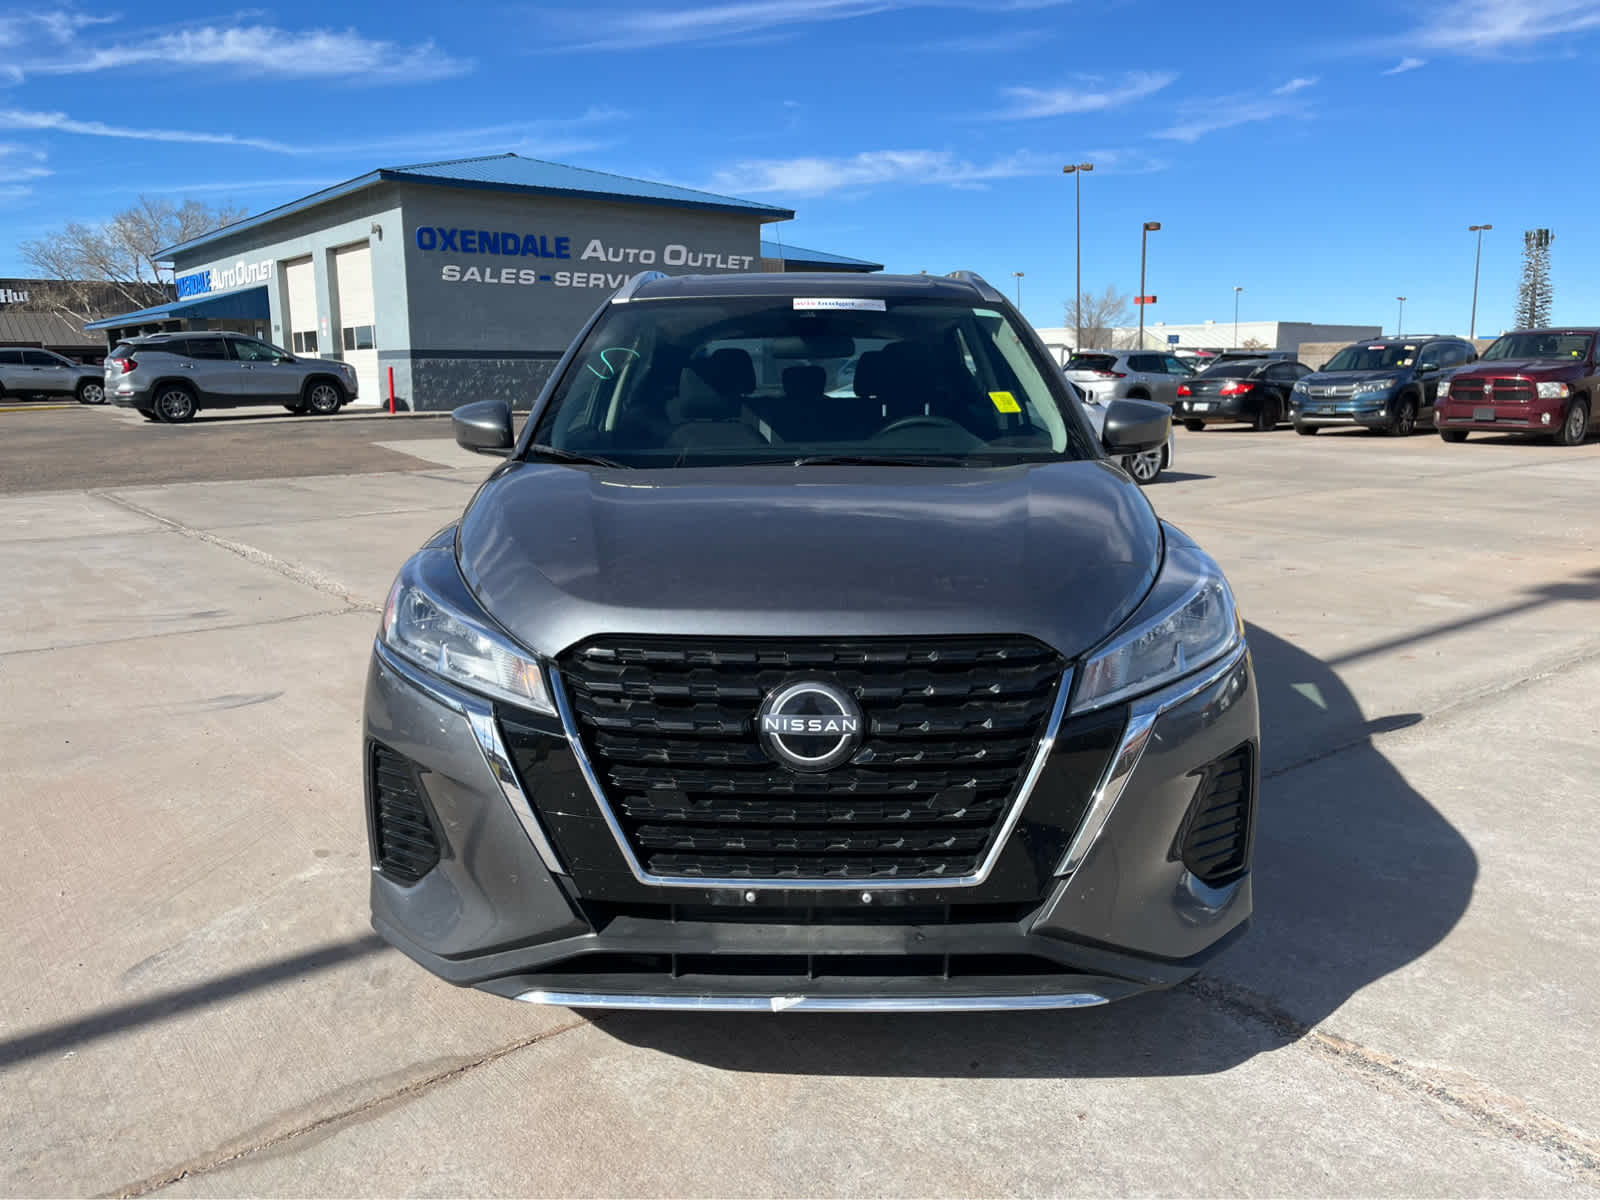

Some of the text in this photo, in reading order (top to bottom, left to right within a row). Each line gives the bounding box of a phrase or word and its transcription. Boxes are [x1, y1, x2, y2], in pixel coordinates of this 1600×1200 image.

[415, 226, 754, 270] OXENDALE AUTO OUTLET
[765, 718, 857, 732] NISSAN
